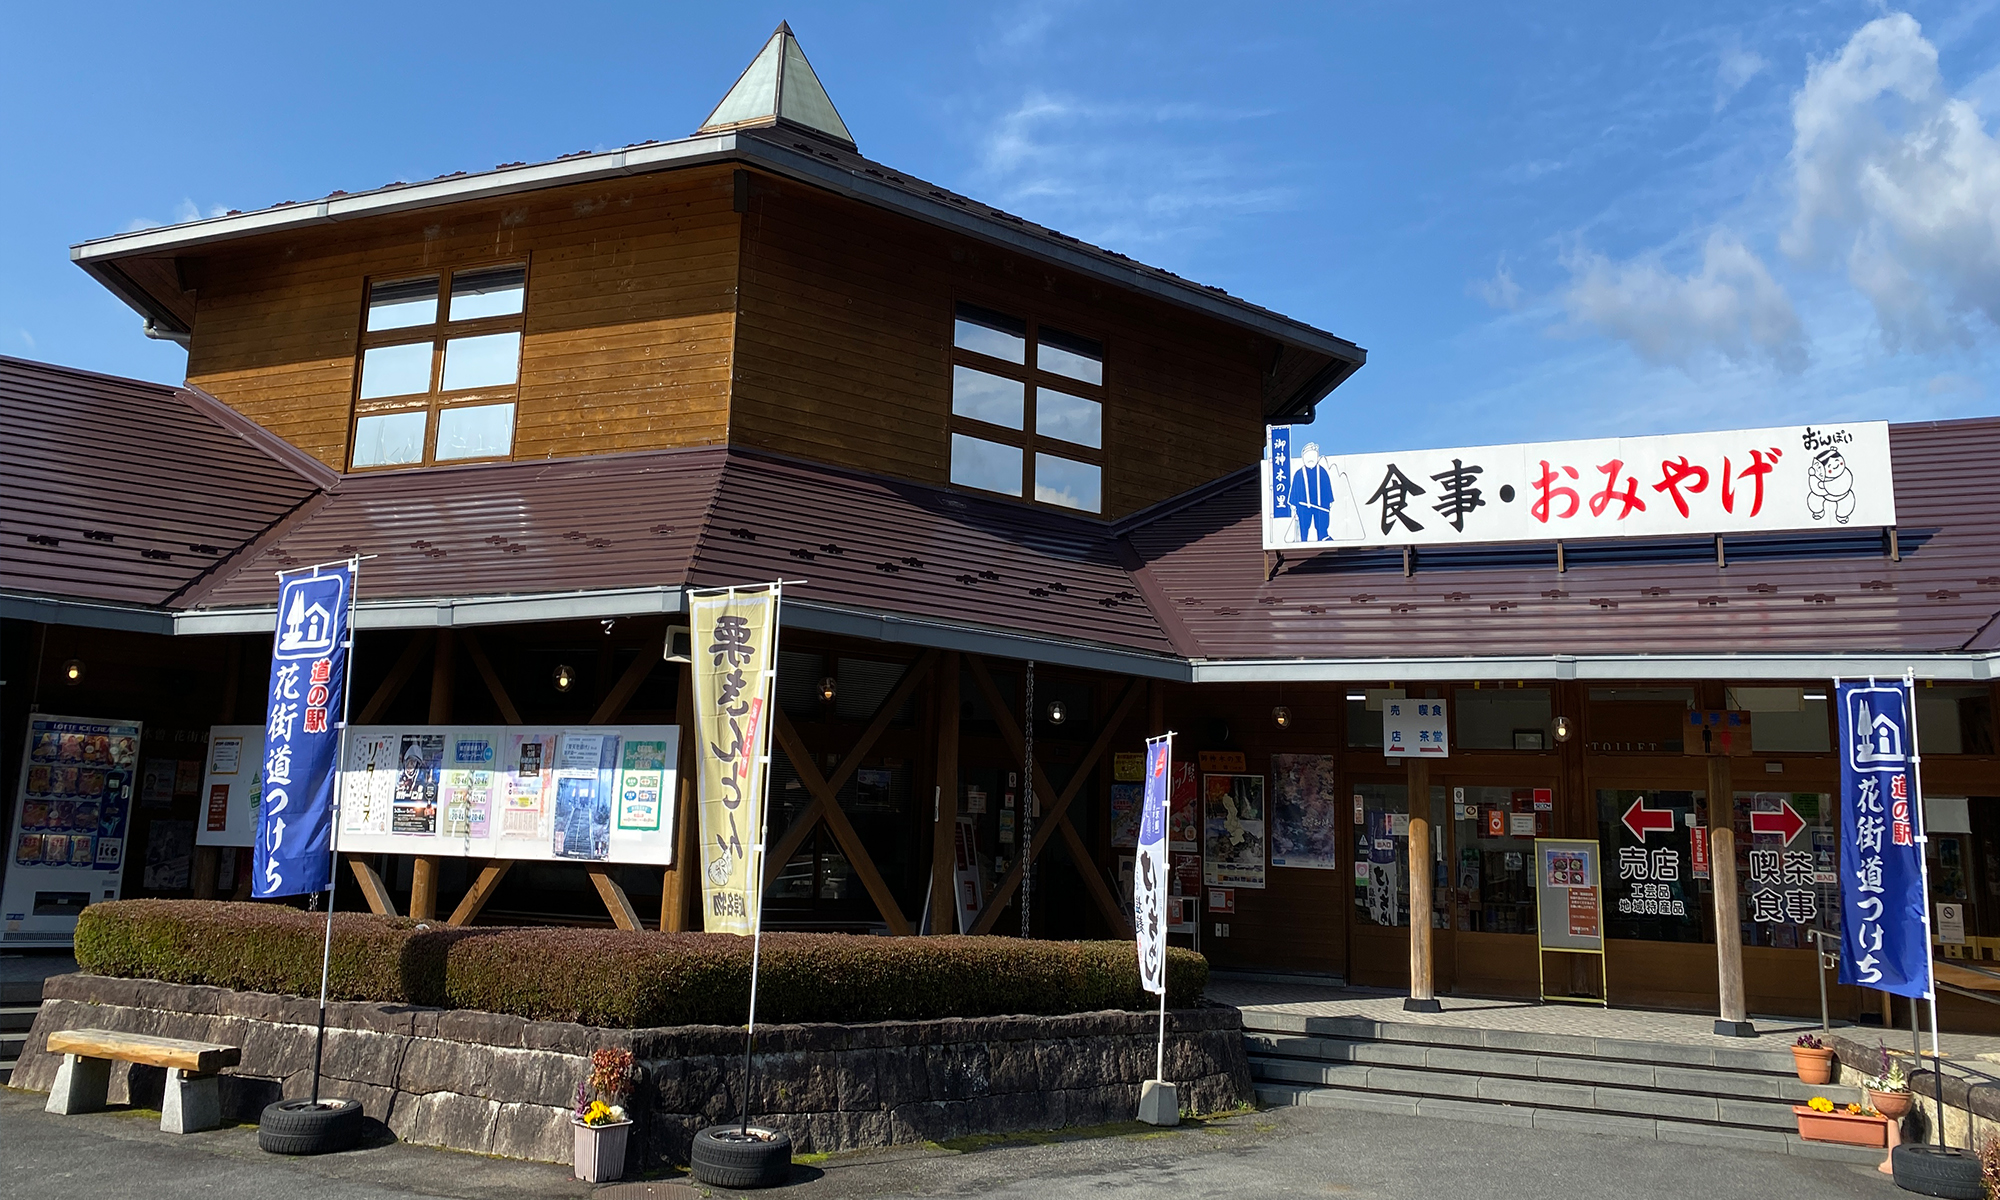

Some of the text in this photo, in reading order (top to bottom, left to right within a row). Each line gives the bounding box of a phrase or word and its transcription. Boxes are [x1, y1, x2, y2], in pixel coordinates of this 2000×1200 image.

[1802, 427, 1853, 451] おんぽい
[1273, 438, 1287, 509] 御神木の里
[1365, 446, 1783, 536] 食事・おみやげ
[303, 657, 333, 735] 道の駅
[53, 723, 77, 731] LOTTE
[1389, 704, 1402, 743] 売店
[1418, 704, 1430, 743] 喫茶
[1431, 704, 1444, 743] 食堂
[1591, 741, 1658, 752] TOILET
[262, 662, 301, 894] 花街道つけち
[1891, 774, 1913, 847] 道の駅
[1618, 846, 1680, 881] 売店
[1749, 849, 1816, 886] 喫茶
[1816, 874, 1834, 882] 出入口
[1856, 775, 1884, 984] 花街道つけち
[1618, 898, 1685, 916] 地域特産品
[1631, 883, 1671, 899] 工芸品
[1752, 888, 1818, 925] 食事
